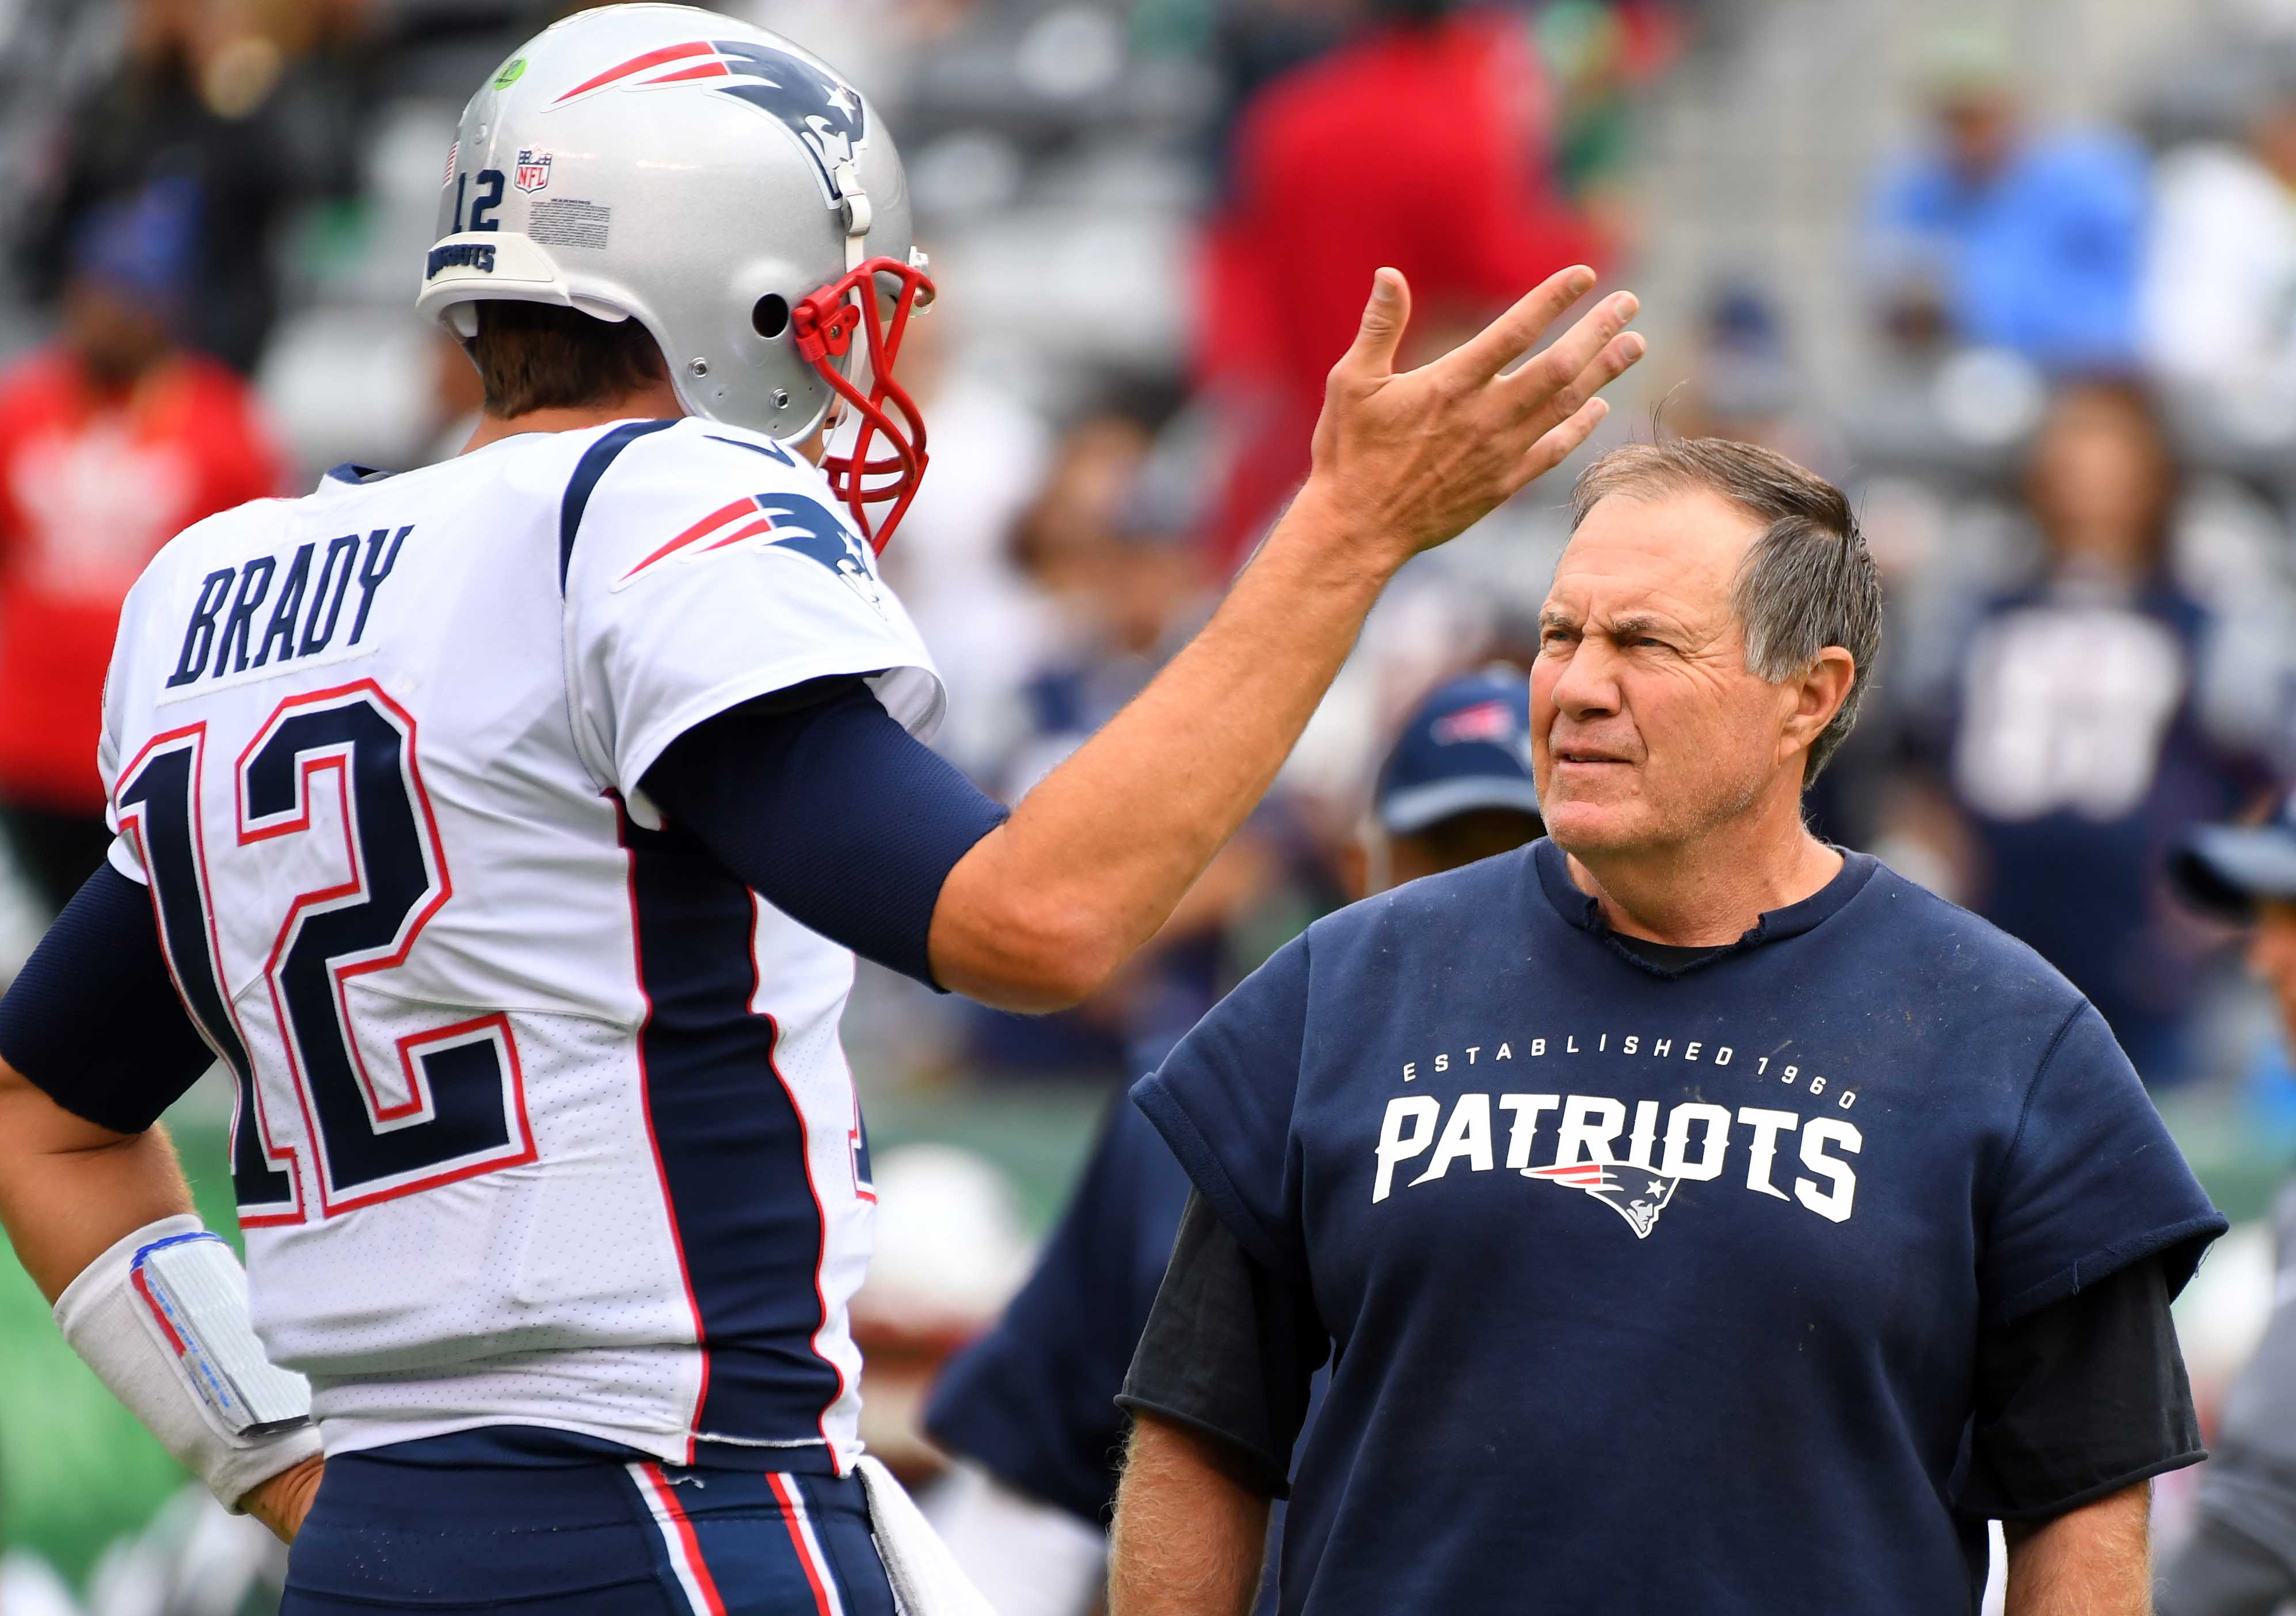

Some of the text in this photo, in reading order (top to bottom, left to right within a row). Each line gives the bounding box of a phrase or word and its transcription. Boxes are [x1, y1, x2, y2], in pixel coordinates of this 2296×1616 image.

[452, 169, 505, 233] 12
[517, 167, 545, 188] NFL
[166, 524, 414, 688] BRADY
[116, 677, 539, 1228] 12
[1403, 1034, 1857, 1110] ESTABLISHED 1960
[1373, 1093, 1863, 1223] PATRIOTS
